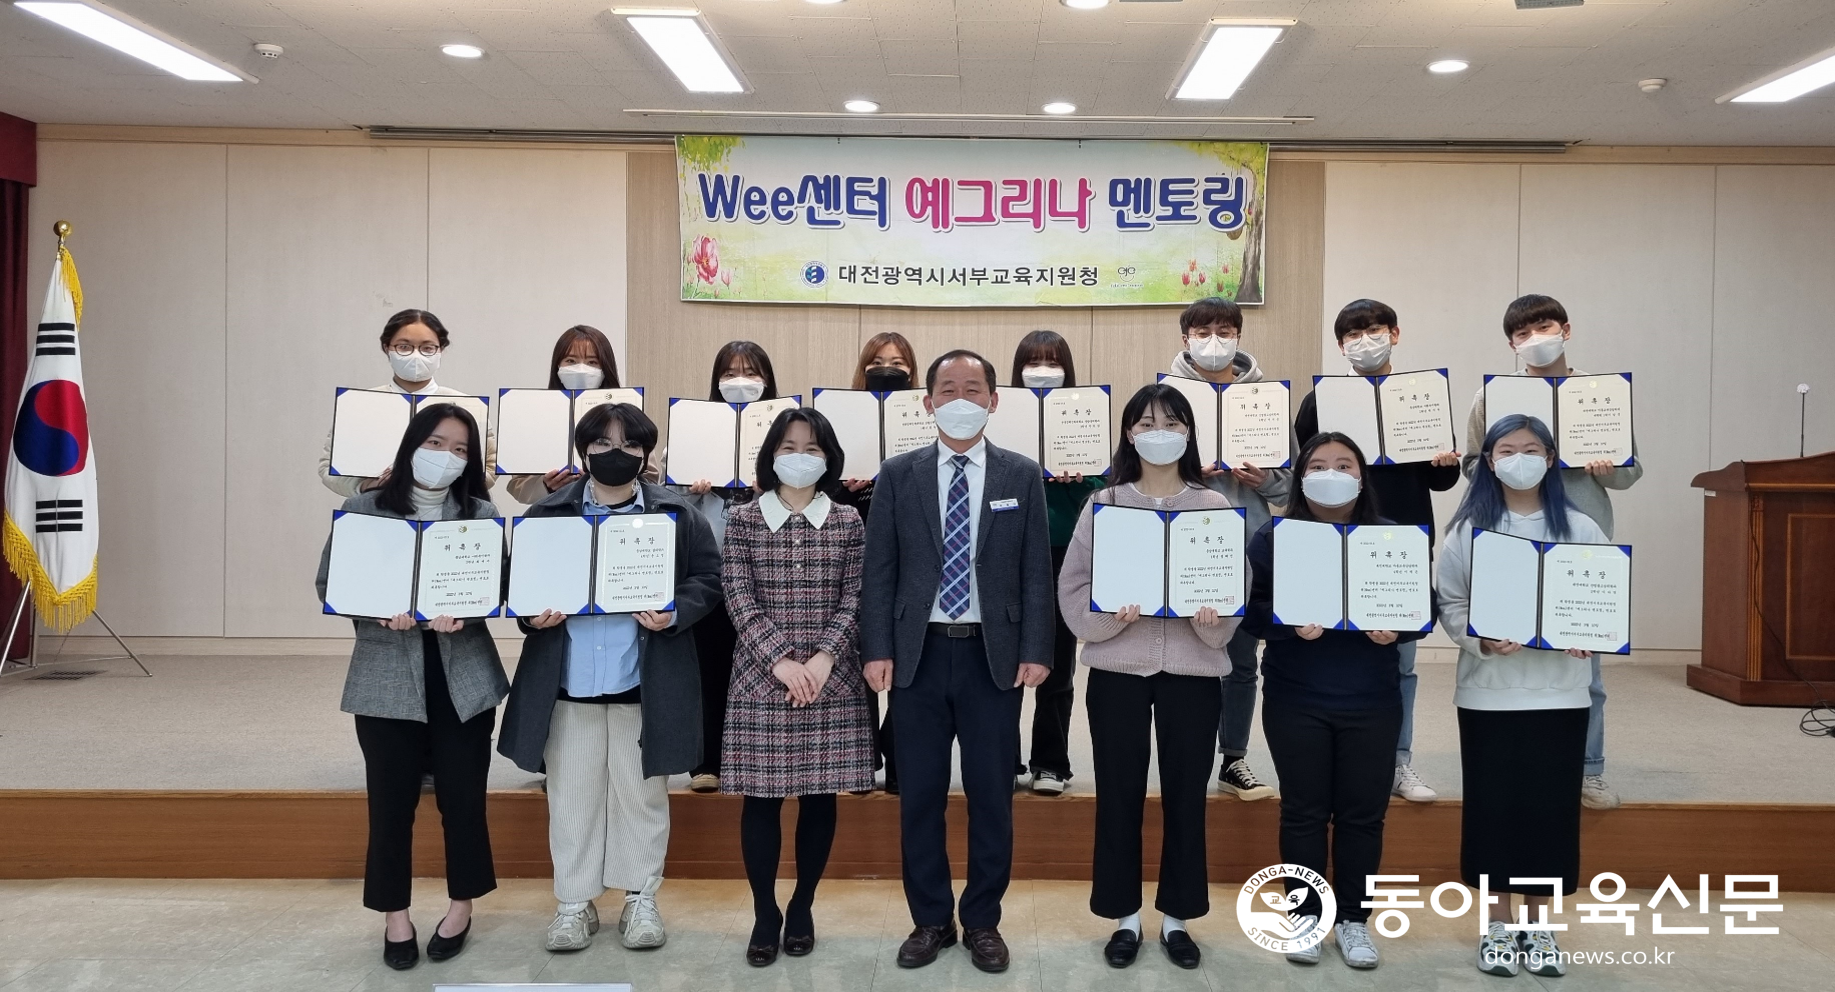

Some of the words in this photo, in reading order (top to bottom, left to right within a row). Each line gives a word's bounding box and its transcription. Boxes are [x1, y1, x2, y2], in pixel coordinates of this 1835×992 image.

[697, 172, 889, 230] Wee센터
[904, 174, 1095, 232] 예그리나
[1107, 174, 1248, 232] 멘토링
[838, 264, 1099, 287] 대전광역시서부교육지원청
